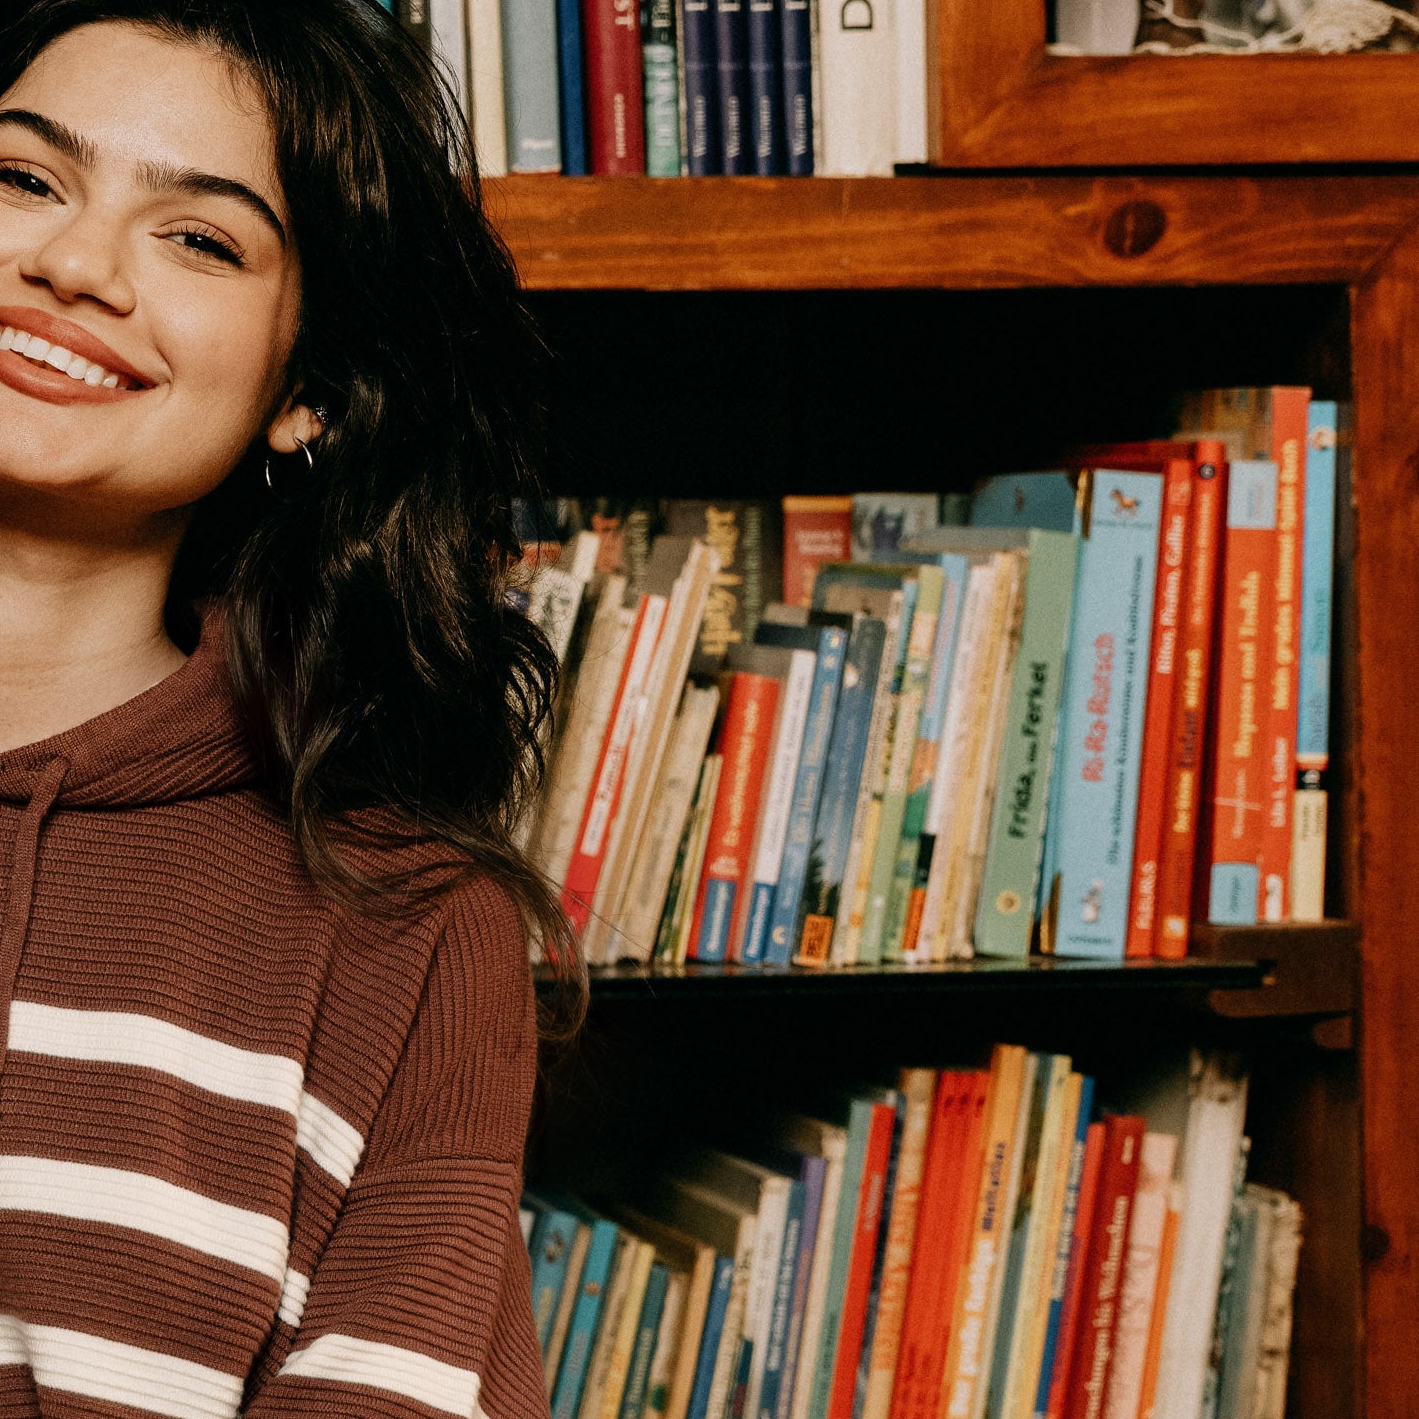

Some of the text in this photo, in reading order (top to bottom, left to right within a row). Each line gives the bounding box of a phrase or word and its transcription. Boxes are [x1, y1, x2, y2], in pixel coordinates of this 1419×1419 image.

[1021, 662, 1046, 738] Ferkel
[1081, 632, 1115, 784] Ri-Ra-Rutsch
[1007, 770, 1037, 840] Frida,
